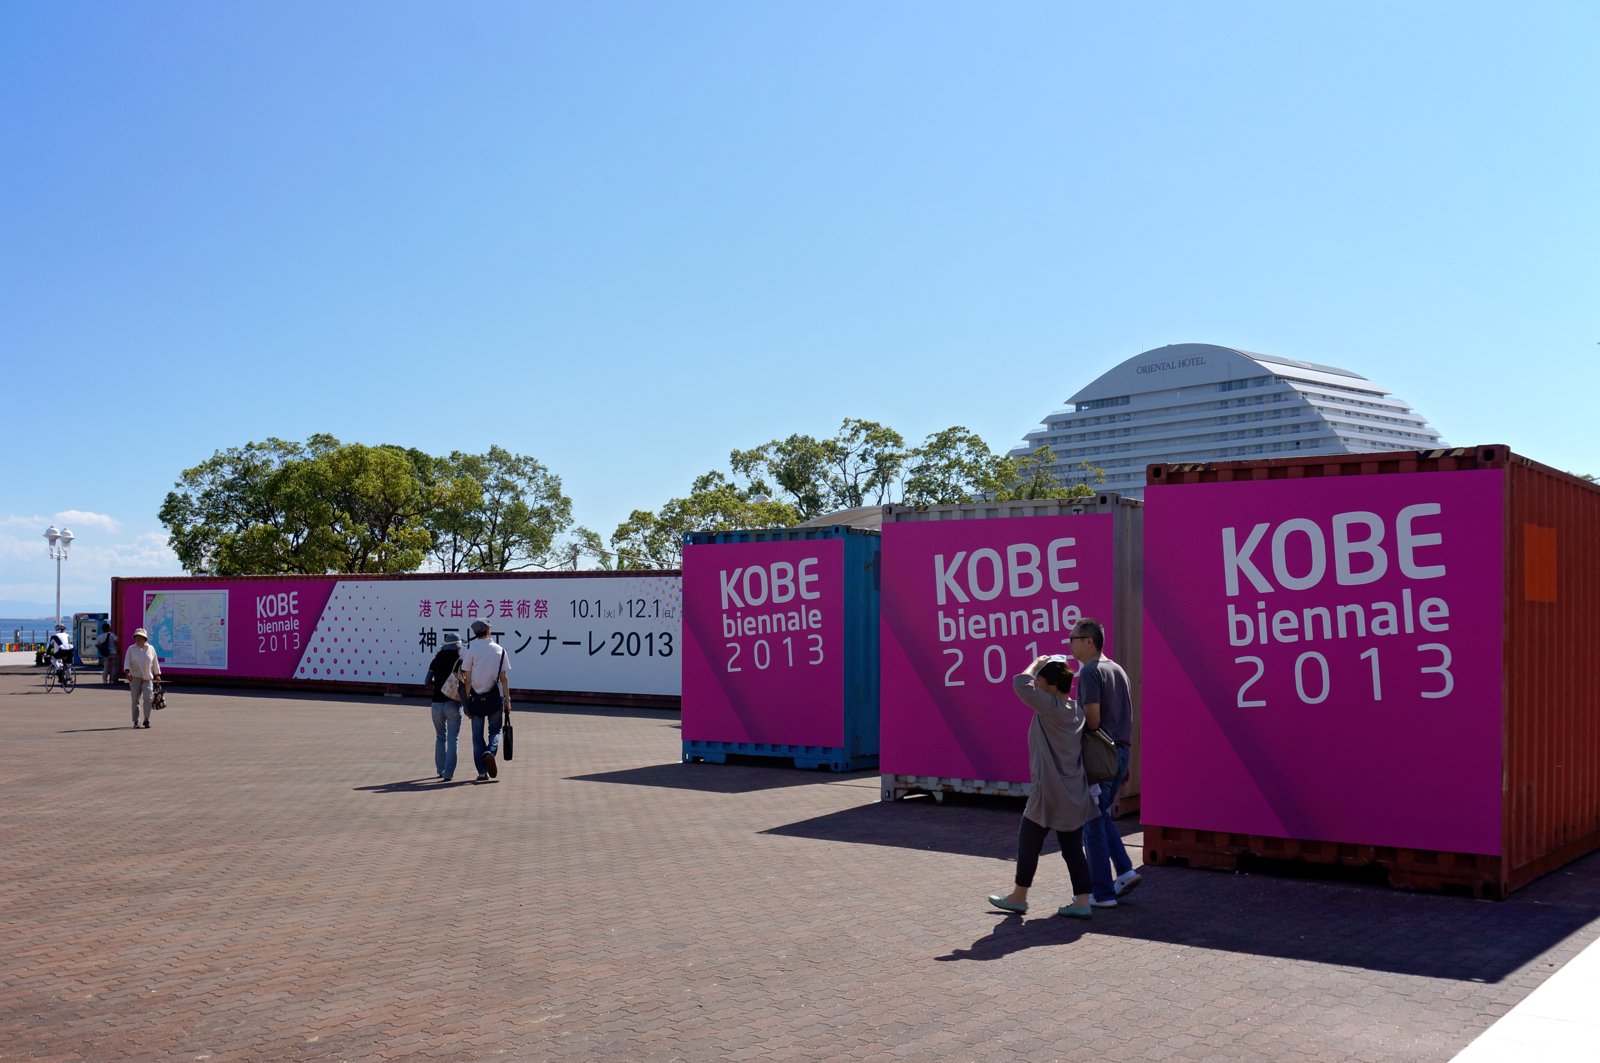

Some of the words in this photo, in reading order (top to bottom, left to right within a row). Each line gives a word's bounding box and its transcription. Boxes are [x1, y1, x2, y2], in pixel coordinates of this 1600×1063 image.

[1136, 360, 1176, 375] ORIENTAL
[1178, 356, 1206, 369] HOTEL
[1222, 503, 1446, 597] KOBE
[719, 557, 821, 610] KOBE
[935, 537, 1080, 606] KOBE
[256, 591, 299, 619] KOBE
[419, 599, 548, 619] 港で出合う芸術祭
[722, 605, 822, 638] biennale
[937, 599, 1082, 642] biennale
[1227, 589, 1450, 647] biennale
[257, 616, 300, 635] biennale
[258, 632, 300, 653] 2013
[726, 634, 824, 673] 2013
[1234, 643, 1454, 708] 2013
